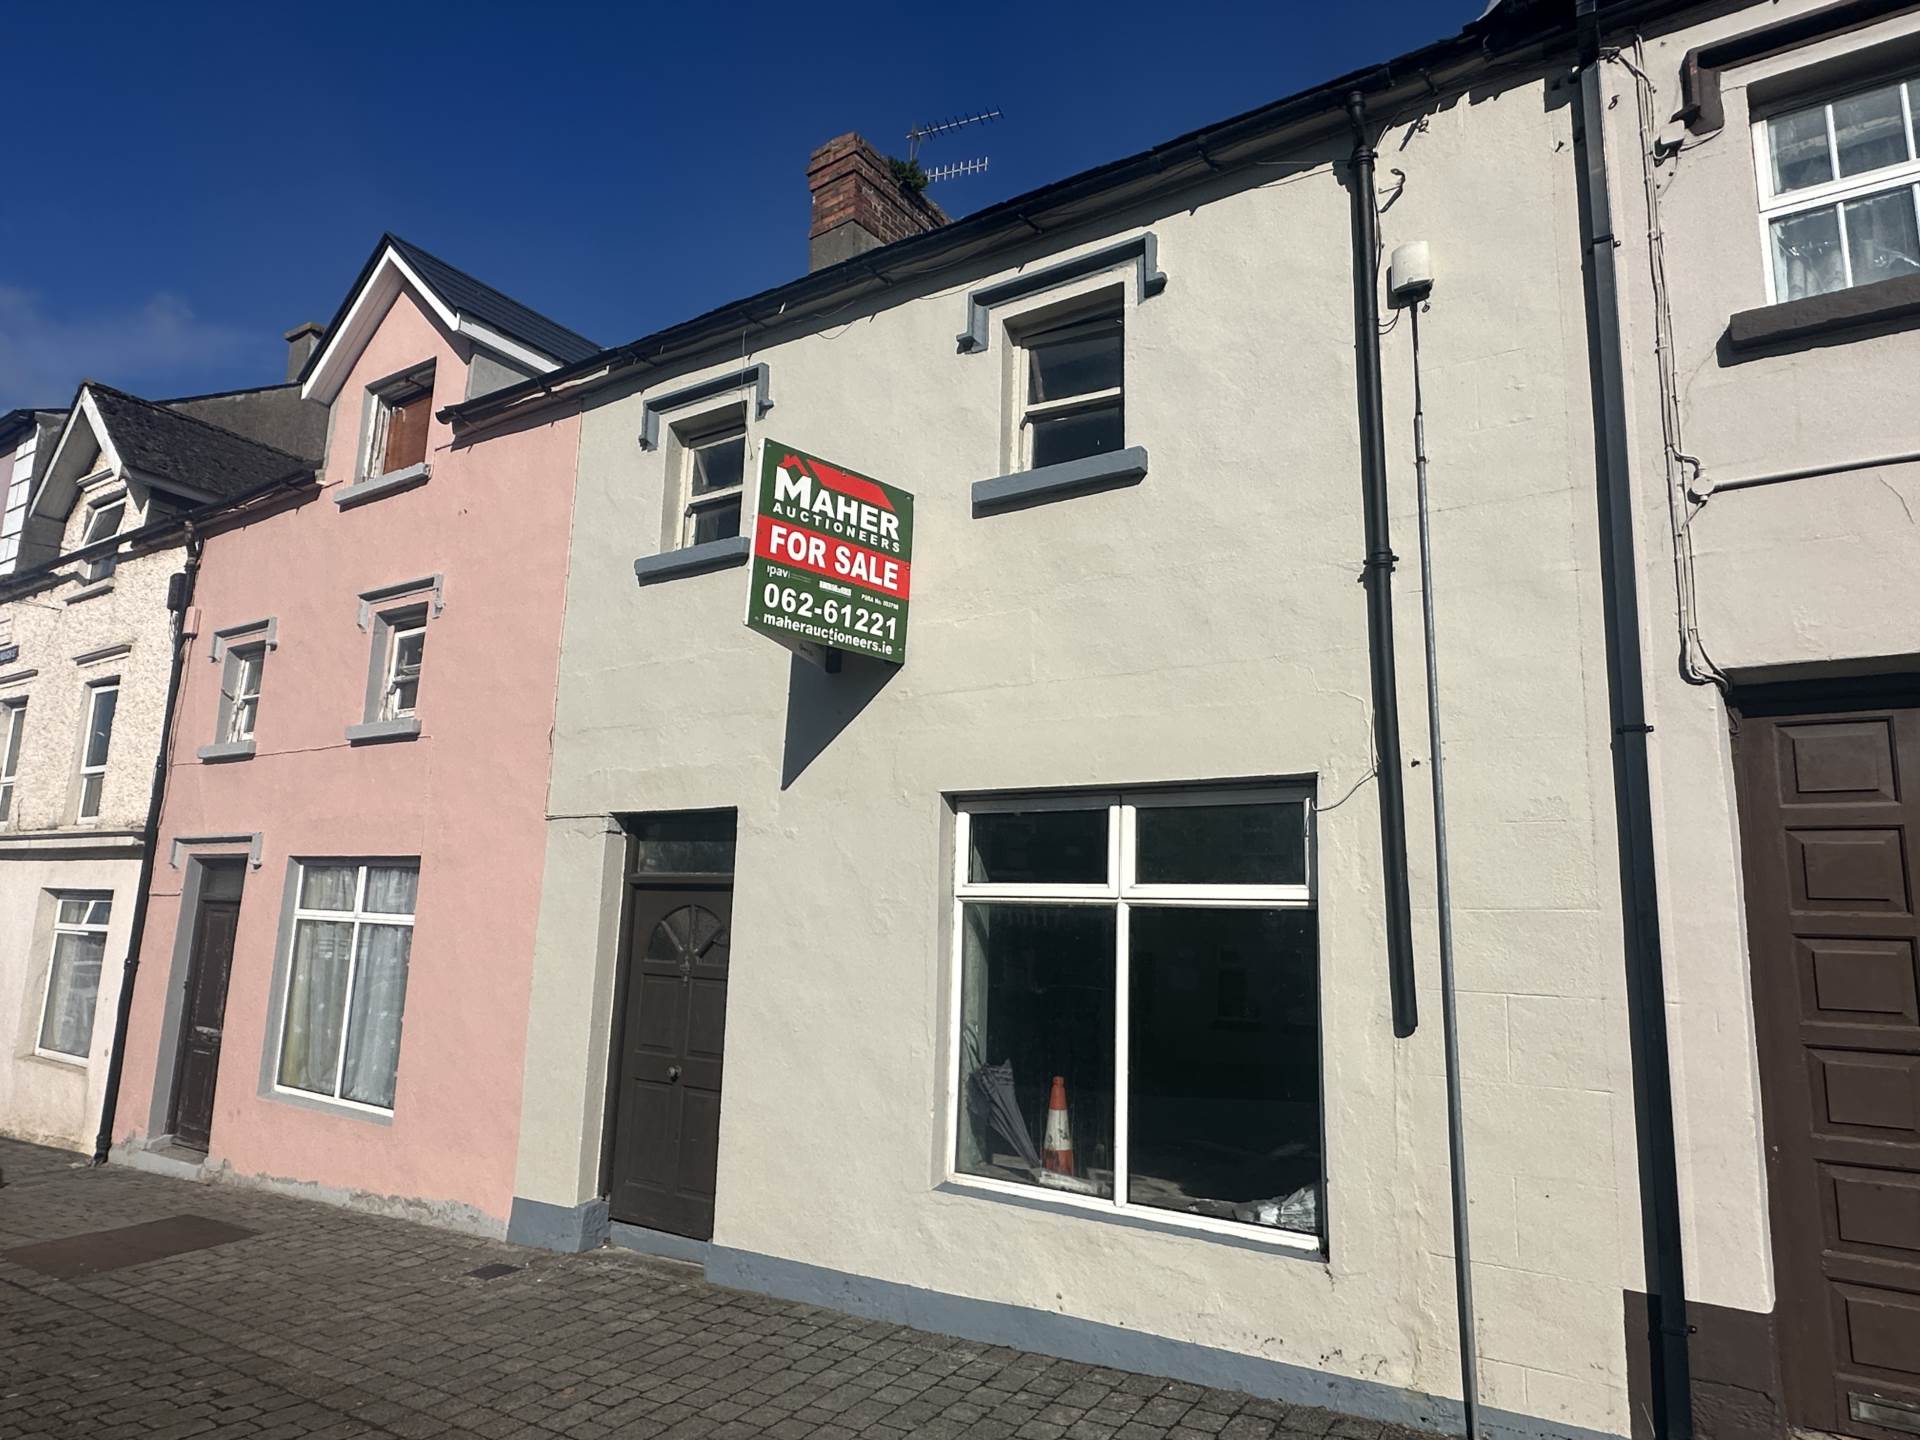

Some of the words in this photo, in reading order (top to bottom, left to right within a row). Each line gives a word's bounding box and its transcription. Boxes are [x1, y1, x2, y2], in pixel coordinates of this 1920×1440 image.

[772, 502, 900, 553] AUCTIONEERS
[774, 466, 900, 540] MAHER
[769, 524, 826, 568] FOR
[834, 545, 898, 590] SALE
[763, 583, 896, 640] 062-61221
[763, 613, 892, 654] maherauctioneers.ie
